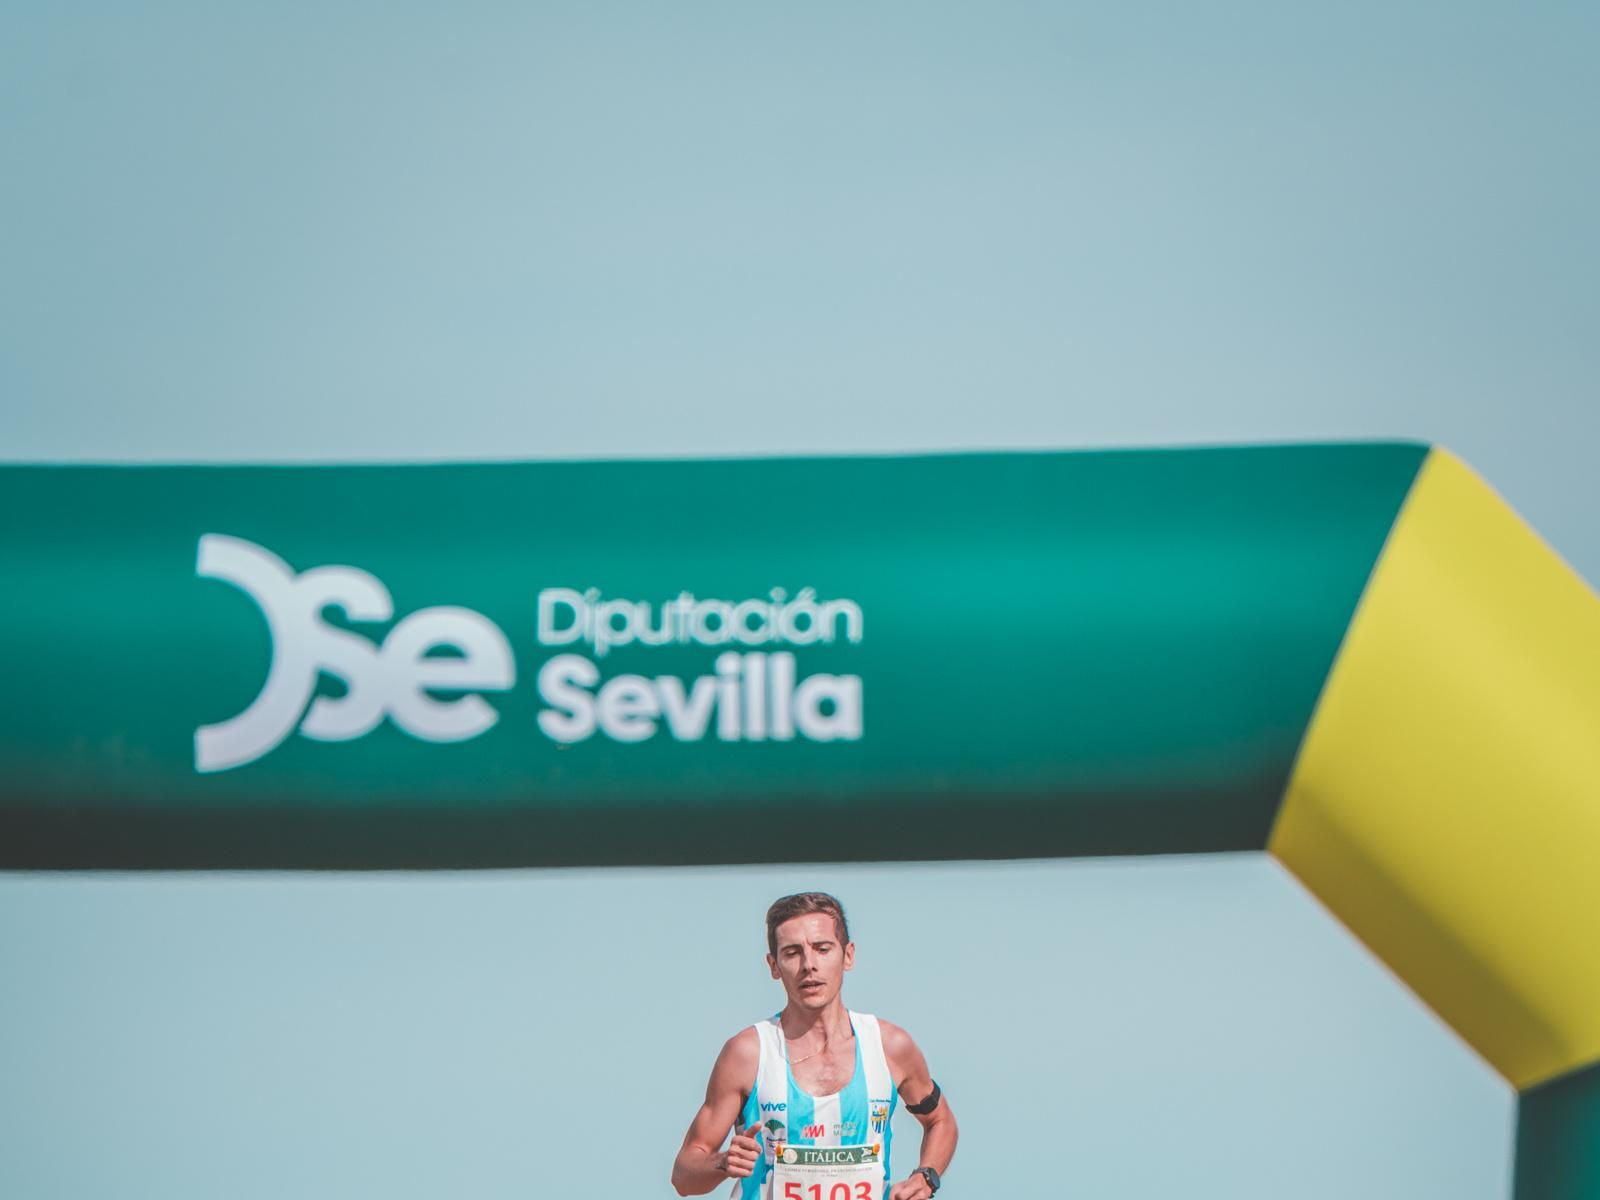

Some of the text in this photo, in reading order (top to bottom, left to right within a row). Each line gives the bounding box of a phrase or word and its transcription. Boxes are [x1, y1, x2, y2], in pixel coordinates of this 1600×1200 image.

[537, 587, 864, 656] Diputación
[537, 652, 864, 743] Sevilla
[760, 1101, 787, 1112] vive
[804, 1150, 855, 1163] ITÁLICA
